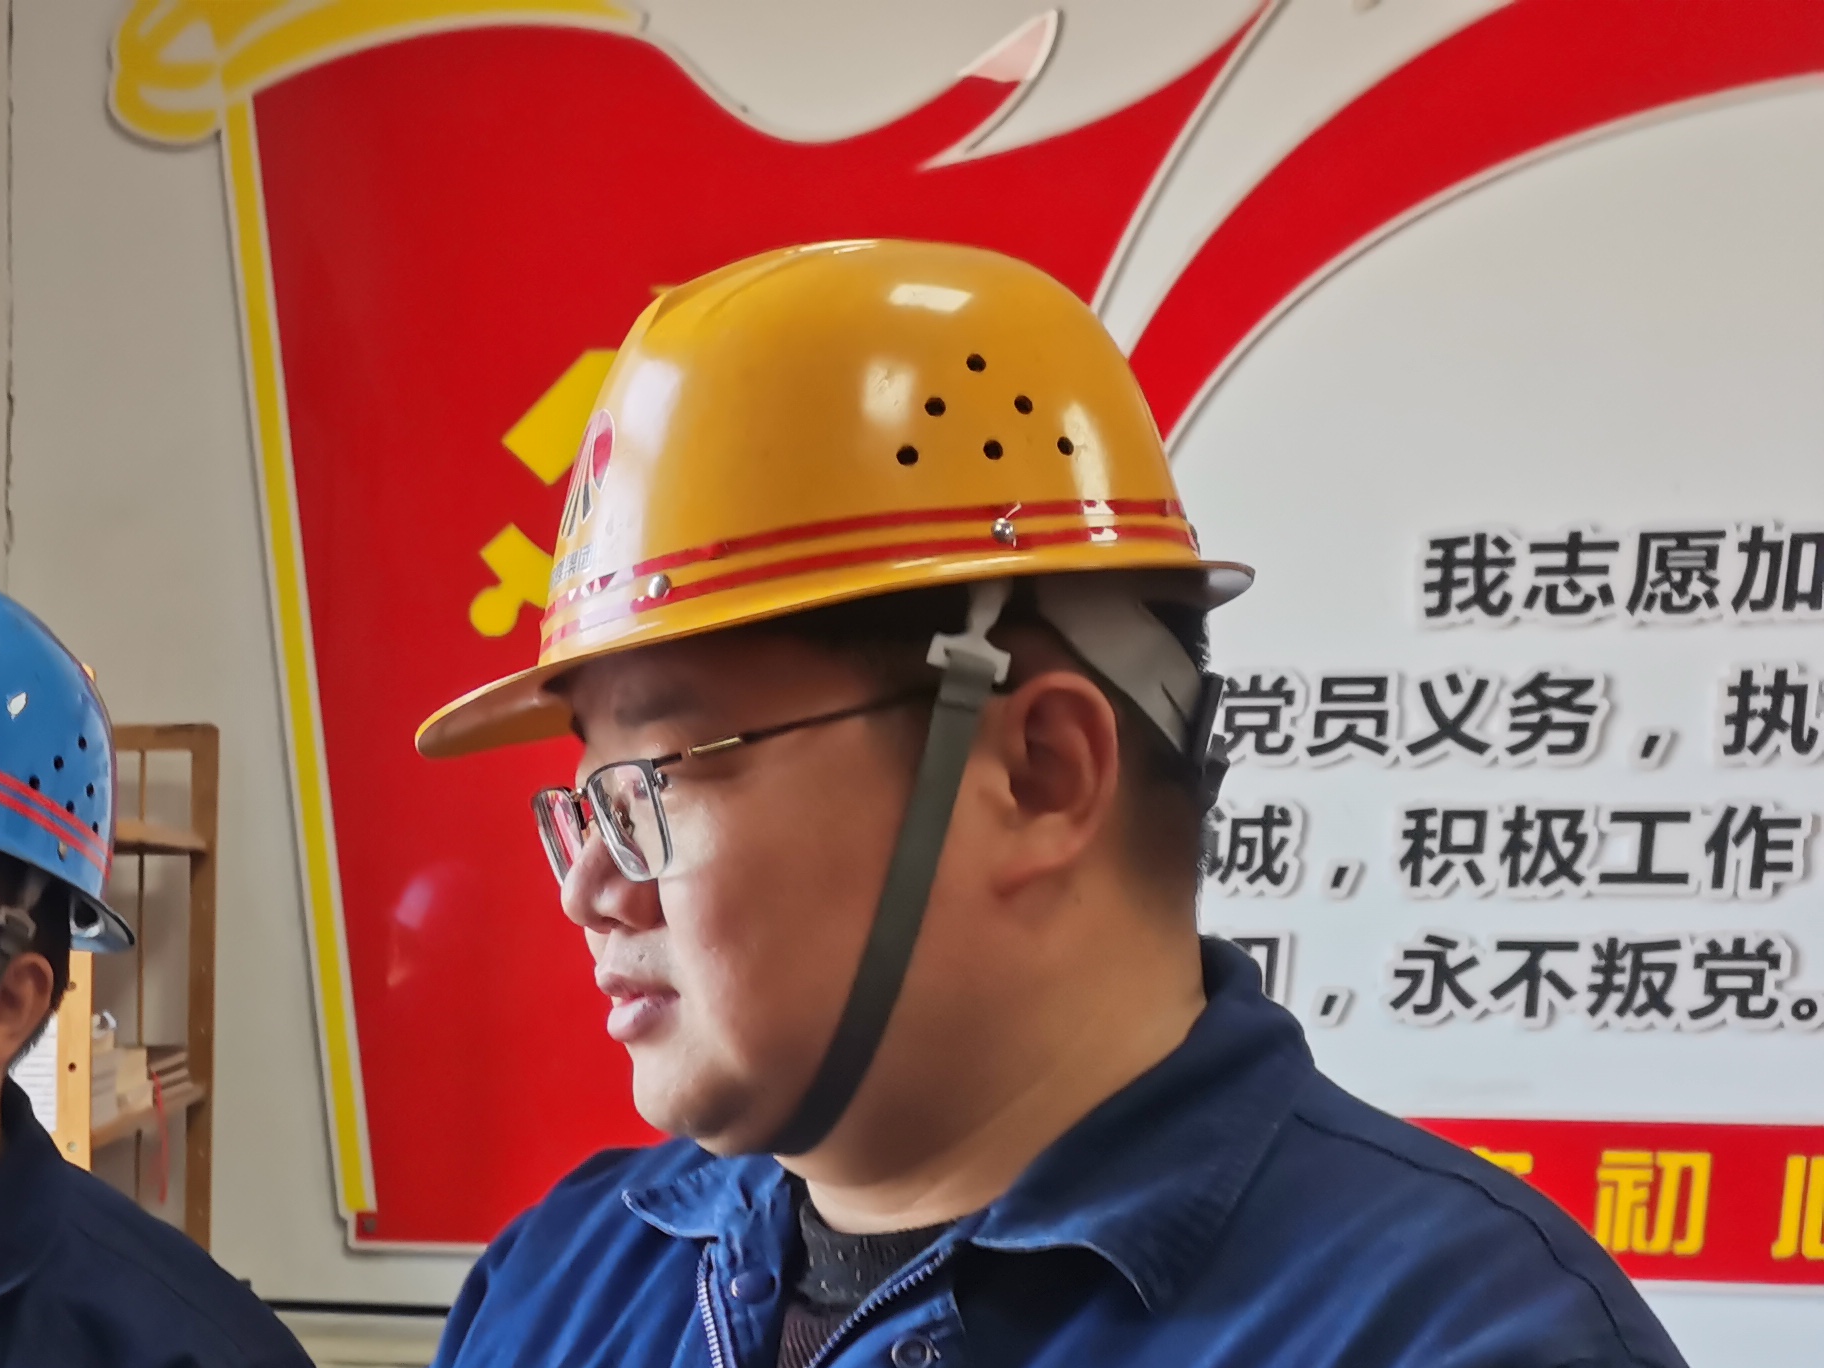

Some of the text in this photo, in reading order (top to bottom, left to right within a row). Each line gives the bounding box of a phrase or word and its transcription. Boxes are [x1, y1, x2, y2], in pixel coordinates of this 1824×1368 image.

[1423, 527, 1824, 616] 我志愿加
[1223, 668, 1819, 757] 党员义务，执
